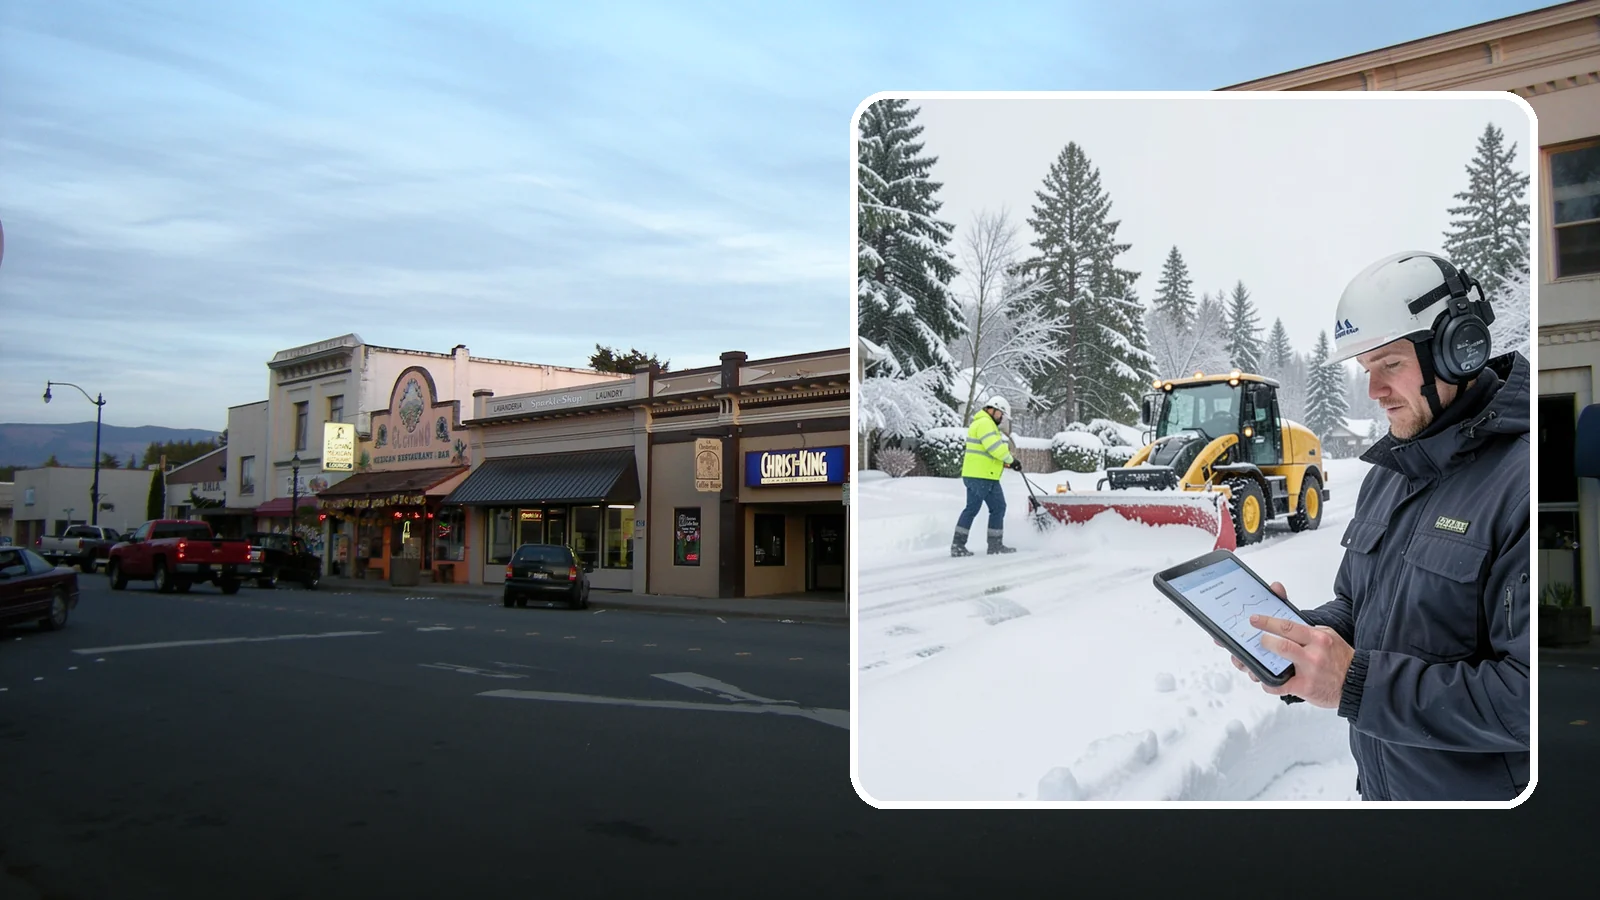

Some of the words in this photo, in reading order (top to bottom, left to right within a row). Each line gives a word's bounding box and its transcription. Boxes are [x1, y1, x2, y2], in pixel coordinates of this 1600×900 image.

[494, 402, 522, 412] LAVANDERIA
[595, 389, 624, 400] LAUNDRY
[373, 455, 396, 464] MEXICAN
[397, 451, 433, 462] RESTAURANT
[438, 450, 450, 459] BAR
[761, 452, 797, 478] CHRIST
[799, 450, 827, 476] KING
